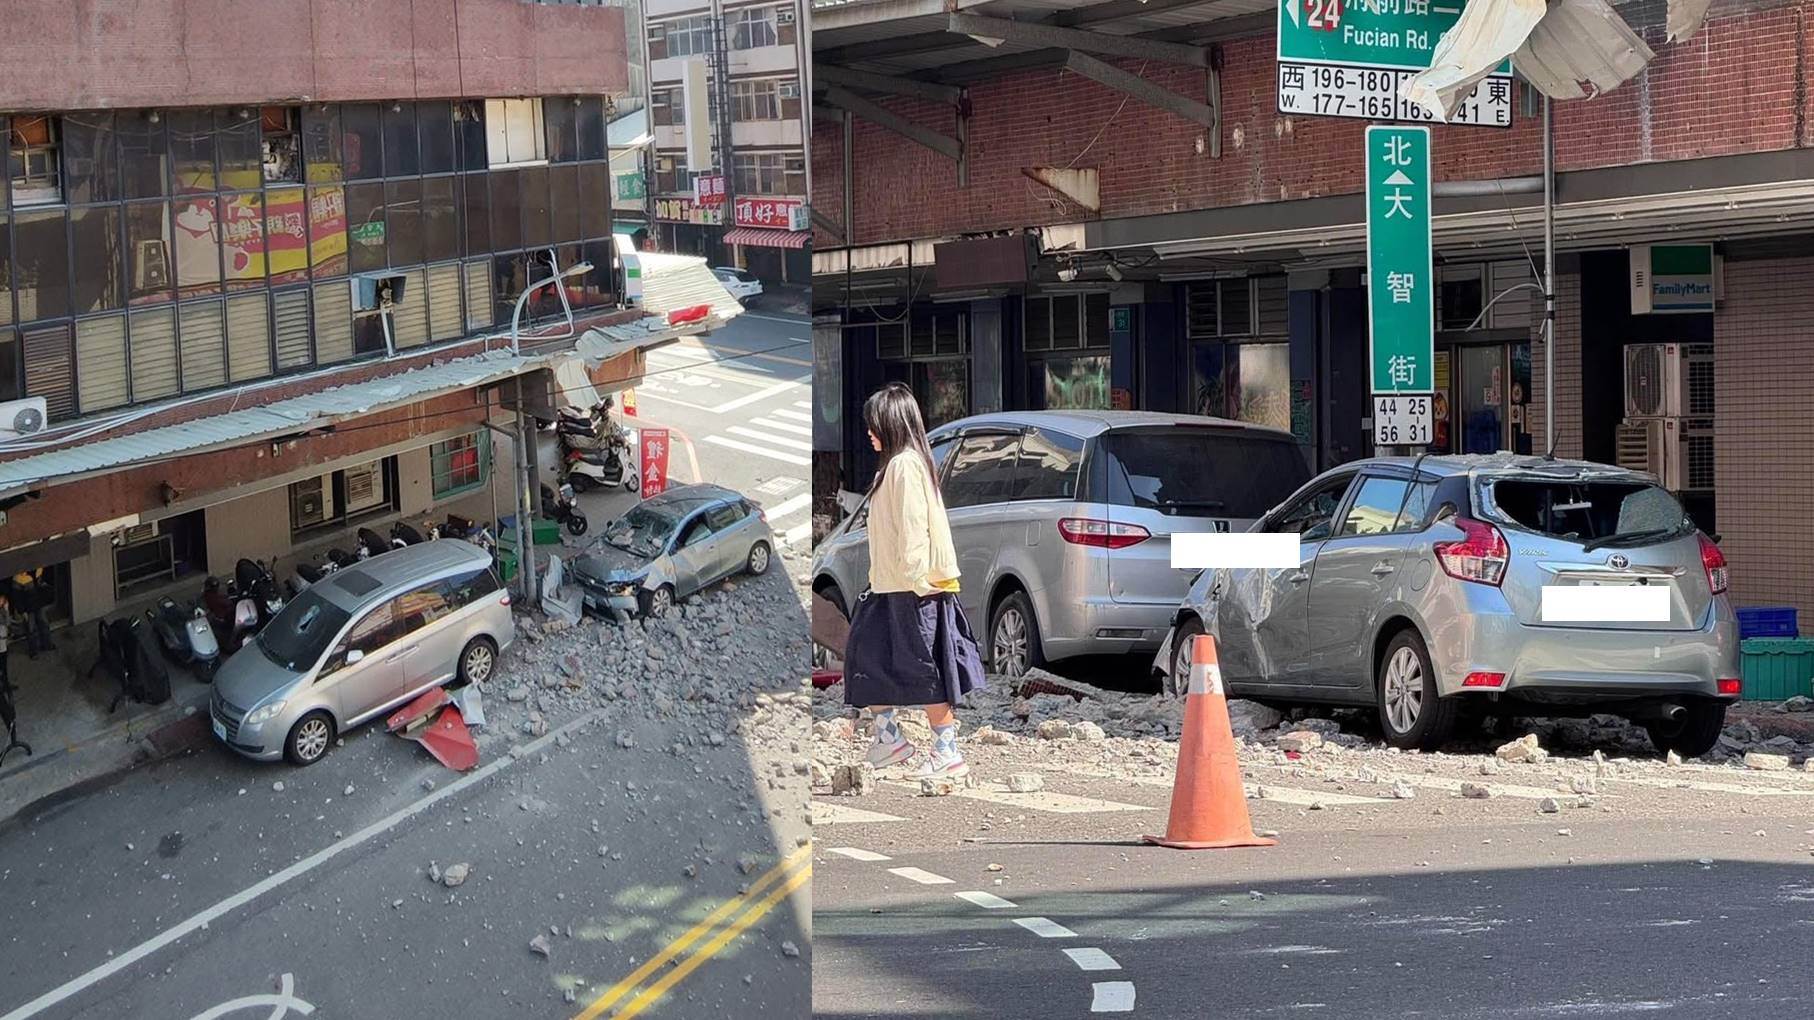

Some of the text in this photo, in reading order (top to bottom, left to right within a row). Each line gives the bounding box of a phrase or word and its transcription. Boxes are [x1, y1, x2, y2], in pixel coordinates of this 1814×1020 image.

[1306, 0, 1341, 29] 24
[1343, 25, 1400, 48] Fucian
[1406, 30, 1432, 50] Rd.
[1281, 65, 1304, 91] 西
[1312, 68, 1390, 93] 196-180
[1281, 94, 1301, 109] W.
[1487, 80, 1509, 106] 東
[1313, 93, 1391, 118] 177-165
[1496, 109, 1510, 123] E.
[1383, 136, 1412, 166] 北
[737, 202, 800, 224] 頂好意
[1383, 187, 1417, 386] 大智街
[1653, 282, 1711, 296] FamilyMart
[1380, 399, 1398, 415] 44
[1408, 399, 1426, 415] 25
[1381, 425, 1398, 442] 56
[1409, 425, 1427, 442] 31
